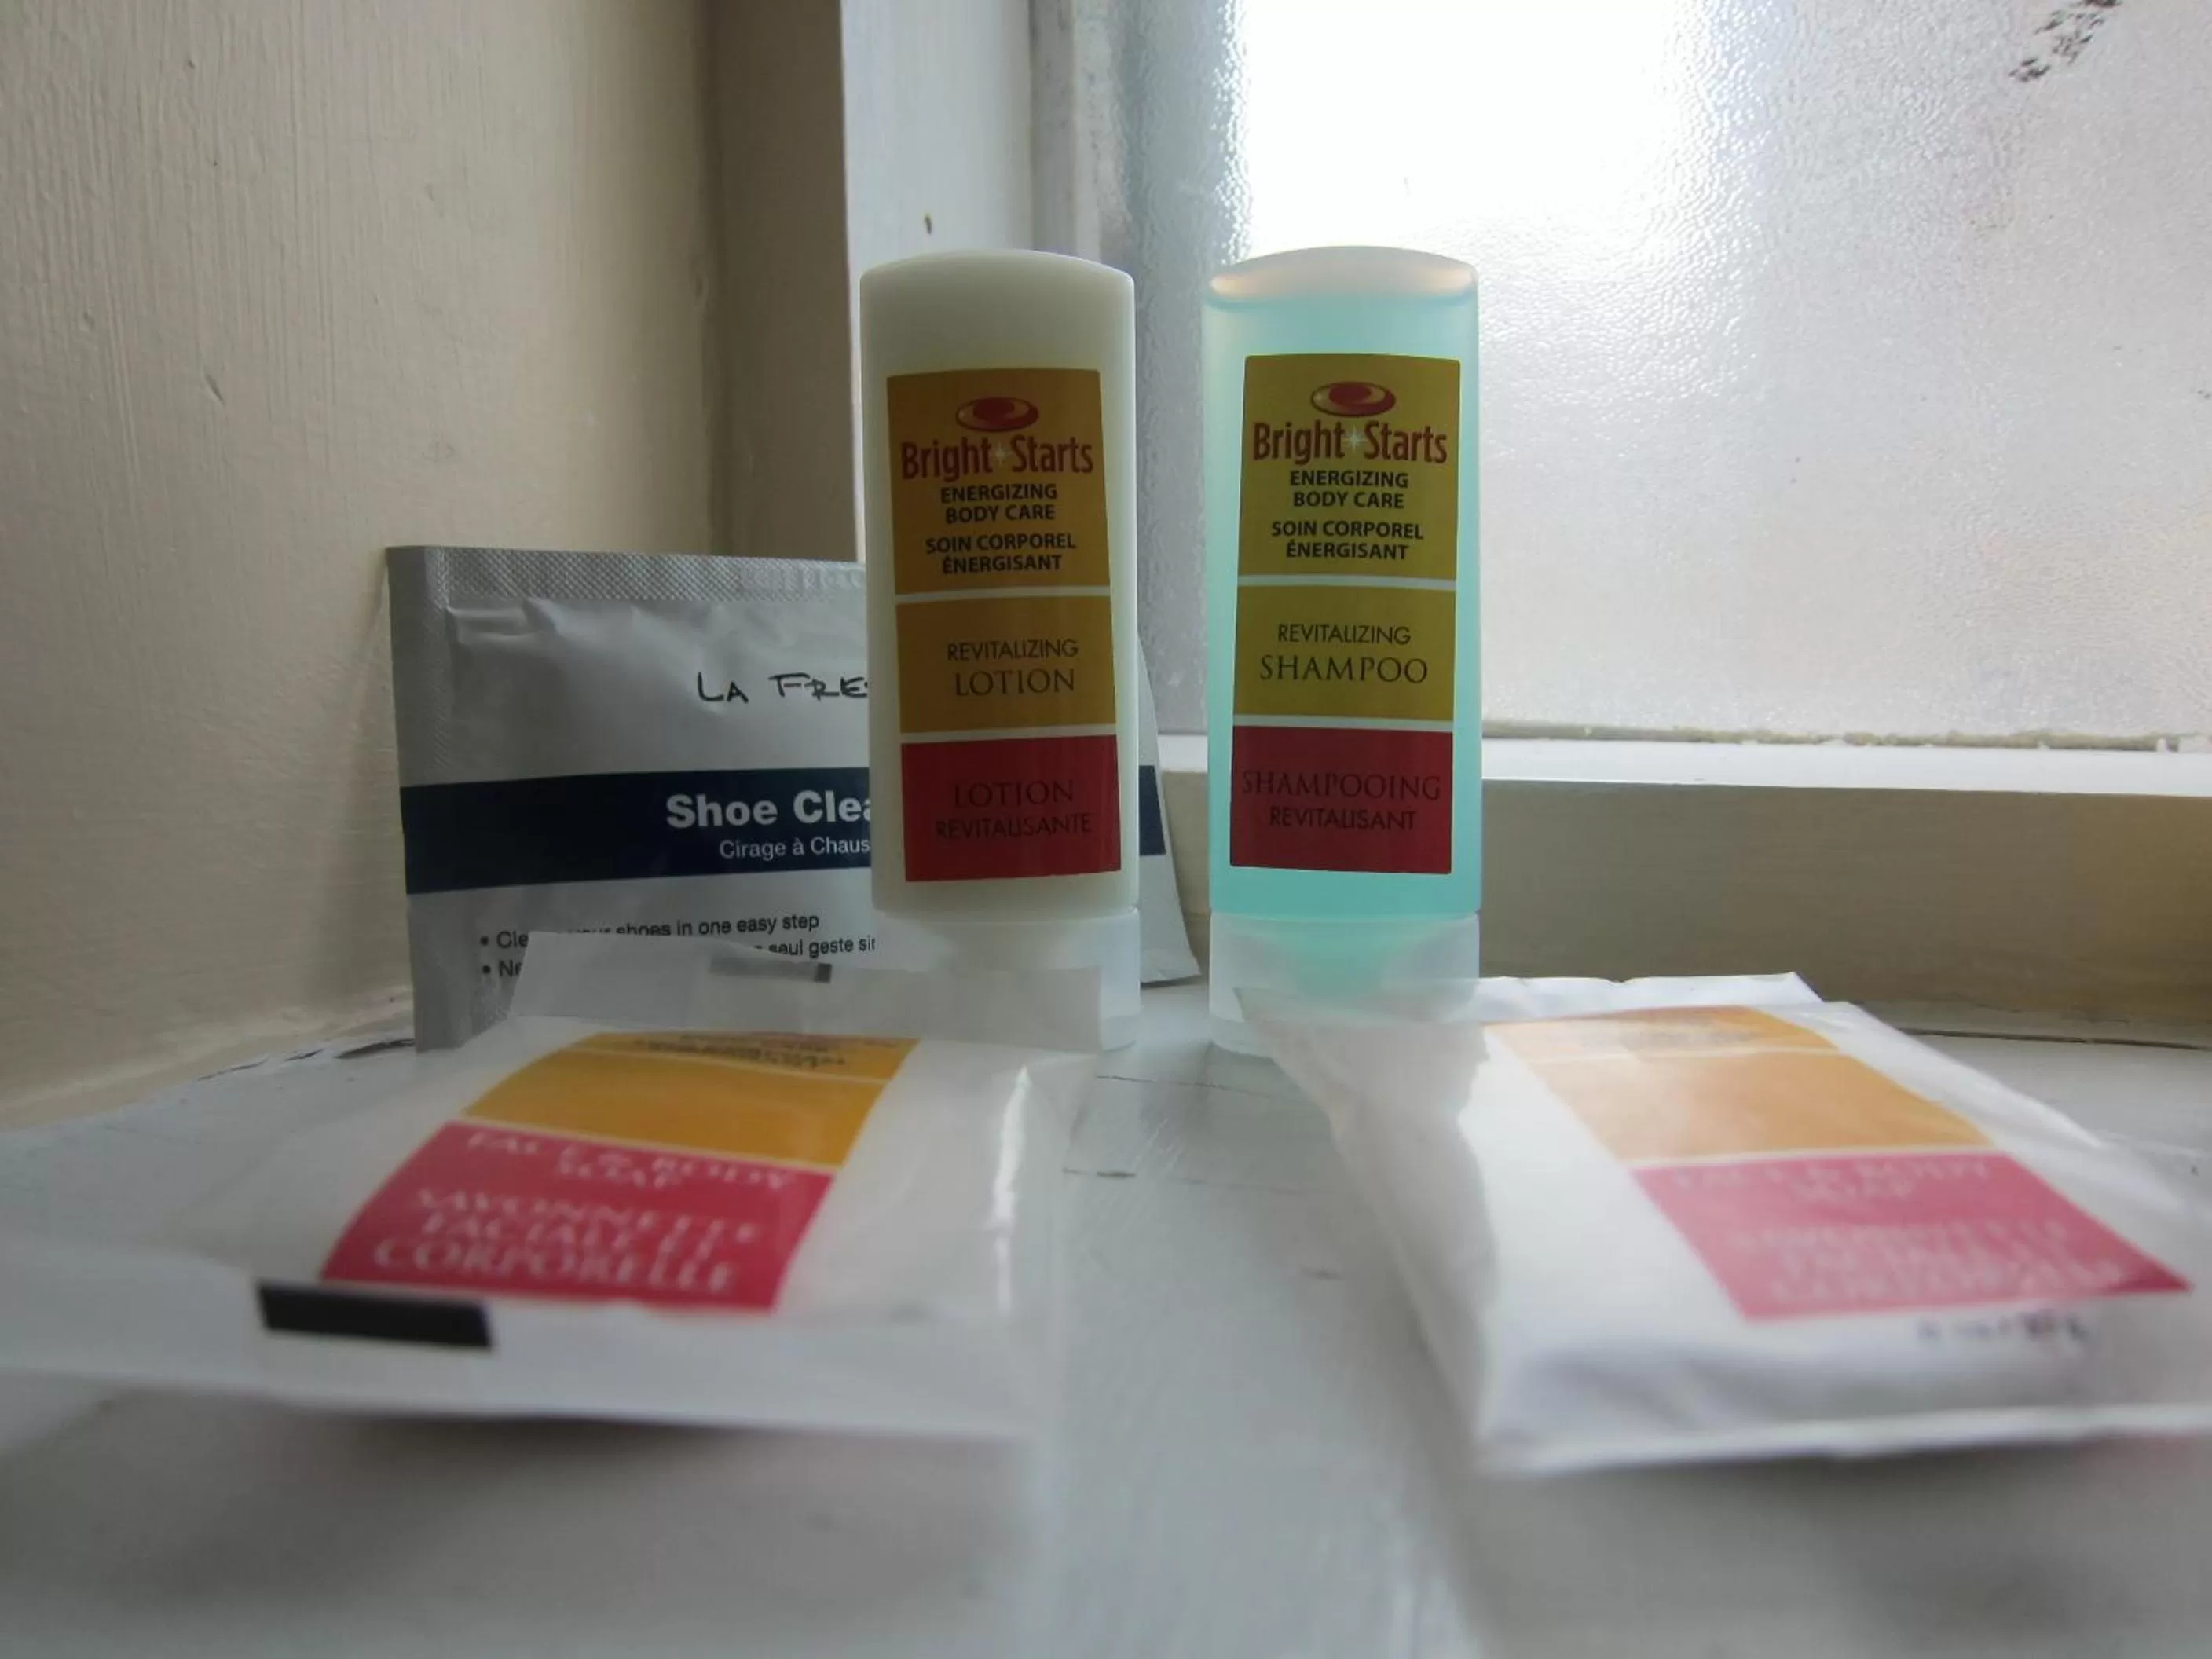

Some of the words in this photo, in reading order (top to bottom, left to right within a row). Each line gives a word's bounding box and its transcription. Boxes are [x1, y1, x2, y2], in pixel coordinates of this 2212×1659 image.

[1252, 419, 1345, 465] Bright
[1364, 420, 1448, 464] Starts
[899, 436, 994, 482] Bright
[1010, 434, 1094, 474] Starts
[1291, 469, 1408, 489] ENERGIZING
[940, 483, 1058, 504] ENERGIZING
[1294, 491, 1349, 507] BODY
[1353, 491, 1404, 509] CARE
[945, 505, 1000, 525] BODY
[1005, 504, 1056, 521] CARE
[1271, 520, 1318, 537] SOIN
[1322, 520, 1424, 540] CORPOREL
[925, 536, 972, 555] SOIN
[976, 533, 1077, 551] CORPOREL
[1286, 539, 1409, 561] ÉNERGISANT
[942, 555, 1062, 575] ÉNERGISANT
[1277, 624, 1412, 646] REVITALIZING
[947, 639, 1079, 661] REVITALIZING
[1259, 654, 1429, 684] SHAMPOO
[697, 672, 749, 703] LA
[767, 672, 869, 701] FRE
[955, 668, 1075, 697] LOTION
[954, 779, 1074, 808] LOTION
[1241, 770, 1441, 801] SHAMPOOING
[666, 793, 778, 829] Shoe
[1269, 806, 1418, 830] REVITALISANT
[934, 811, 1093, 840] REVITALISANTE
[719, 837, 786, 862] Cirage
[792, 837, 805, 856] à
[677, 920, 692, 936] in
[698, 921, 731, 935] one
[737, 917, 777, 936] easy
[782, 914, 819, 932] step
[809, 938, 854, 958] geste
